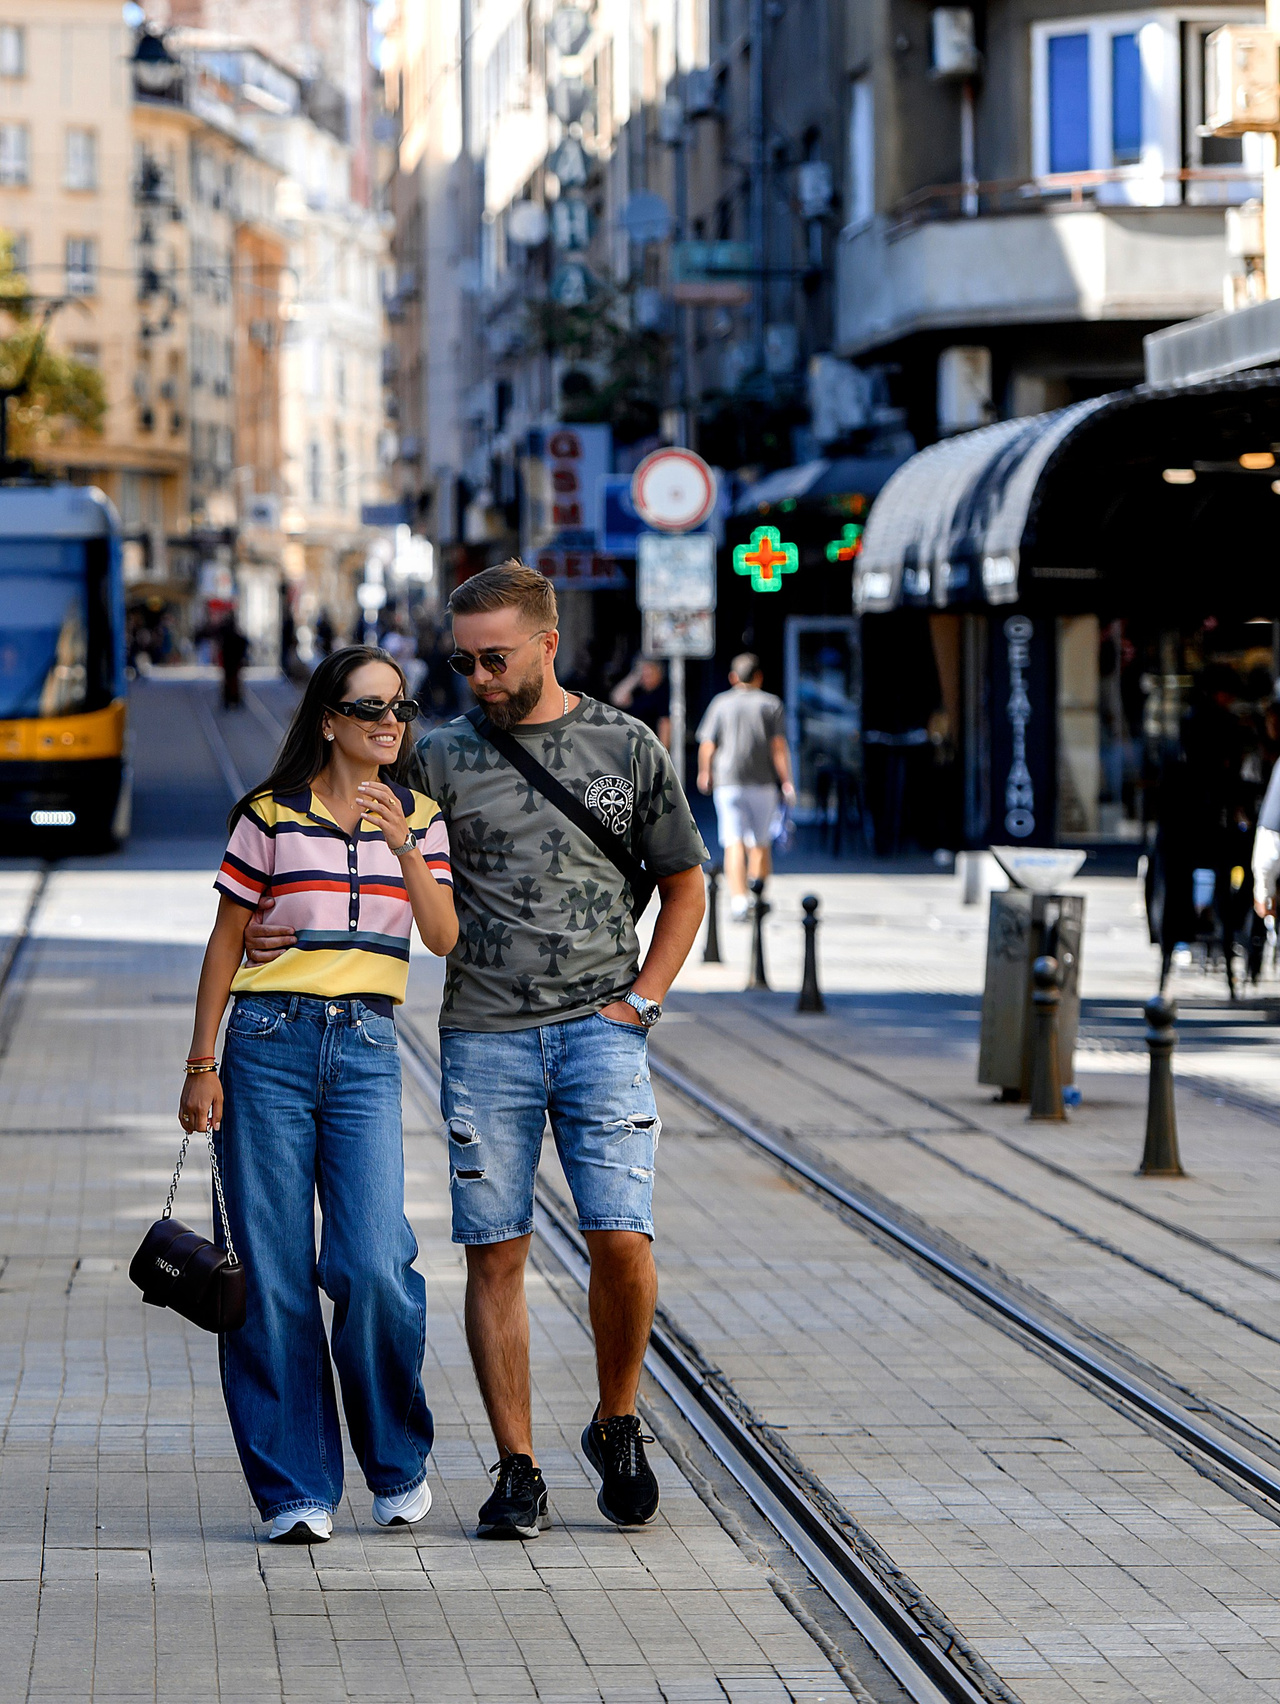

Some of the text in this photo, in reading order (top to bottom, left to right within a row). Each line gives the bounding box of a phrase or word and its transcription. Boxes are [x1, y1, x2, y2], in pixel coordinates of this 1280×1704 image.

[587, 778, 634, 811] BROKEN HEARTS
[154, 1257, 180, 1277] HUGO
